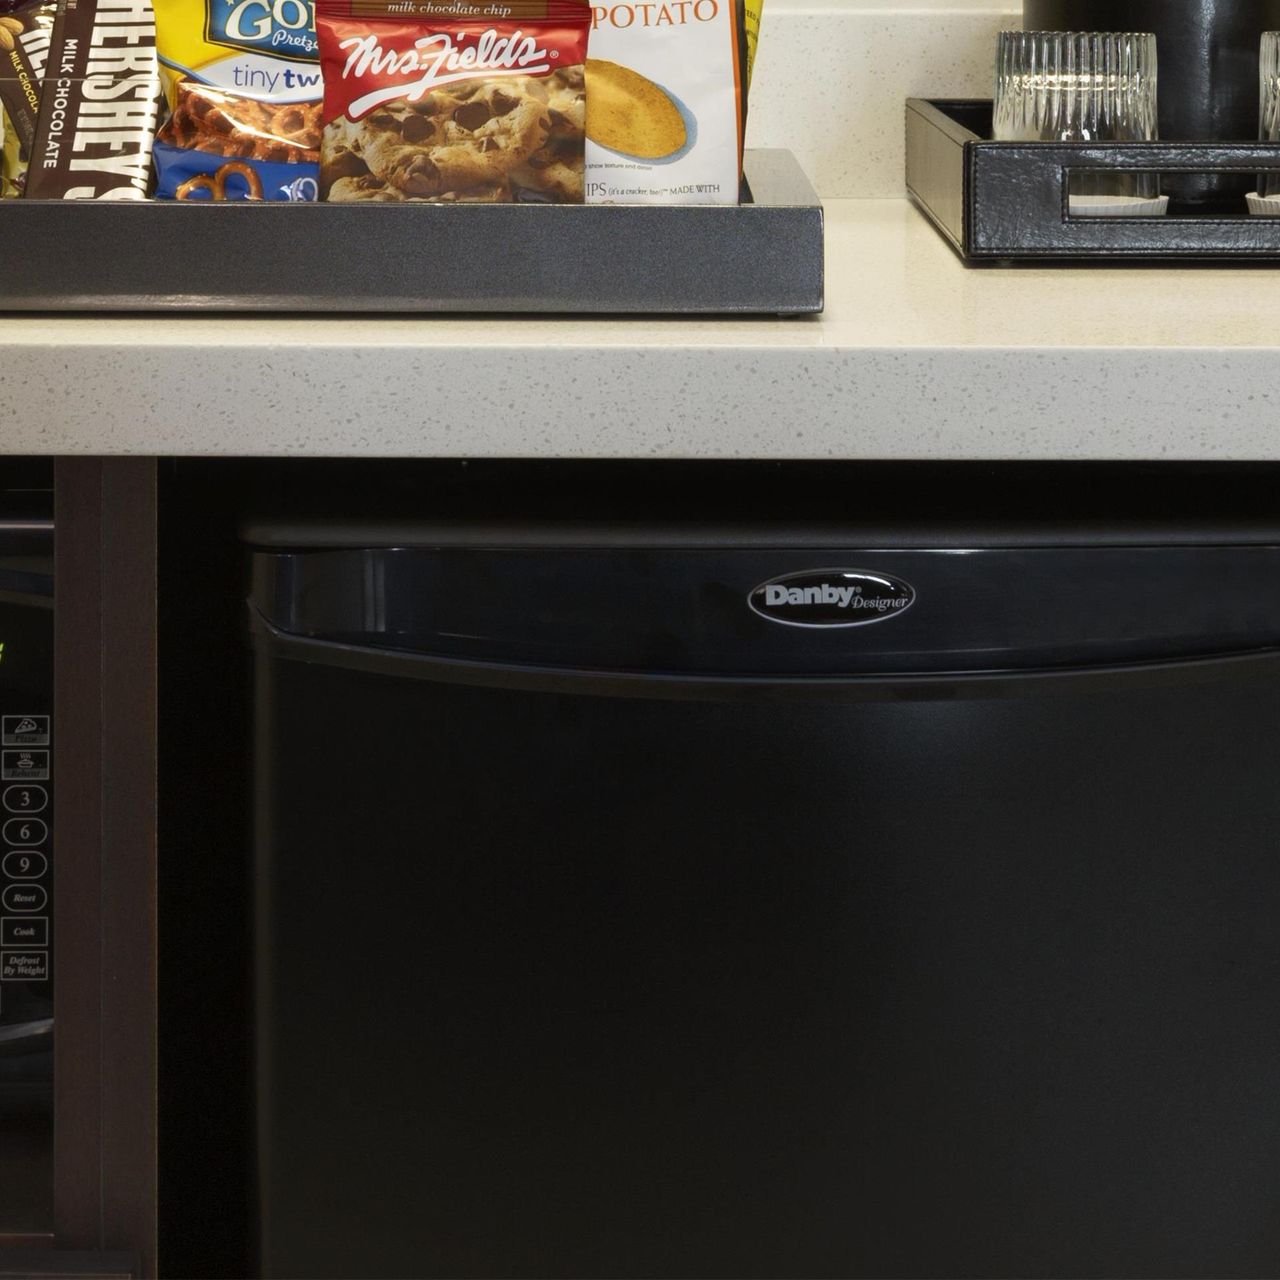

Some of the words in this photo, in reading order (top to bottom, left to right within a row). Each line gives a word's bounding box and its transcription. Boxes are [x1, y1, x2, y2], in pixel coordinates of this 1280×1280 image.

[387, 1, 417, 14] milk
[483, 2, 512, 18] chip
[60, 38, 79, 73] MILK
[339, 35, 428, 80] Mrs.
[8, 51, 24, 78] MILK
[233, 65, 280, 92] tiny
[43, 77, 70, 169] CHOCOLATE
[670, 185, 694, 195] MADE
[696, 184, 720, 194] WITH
[766, 584, 855, 608] Danby
[851, 596, 908, 612] Designer
[20, 792, 30, 808] 3
[20, 825, 30, 840] 6
[20, 858, 30, 873] 9
[13, 894, 36, 903] Reset
[13, 927, 35, 936] Cook
[9, 956, 40, 967] Defrost
[4, 966, 15, 976] By
[17, 966, 45, 977] Weight
